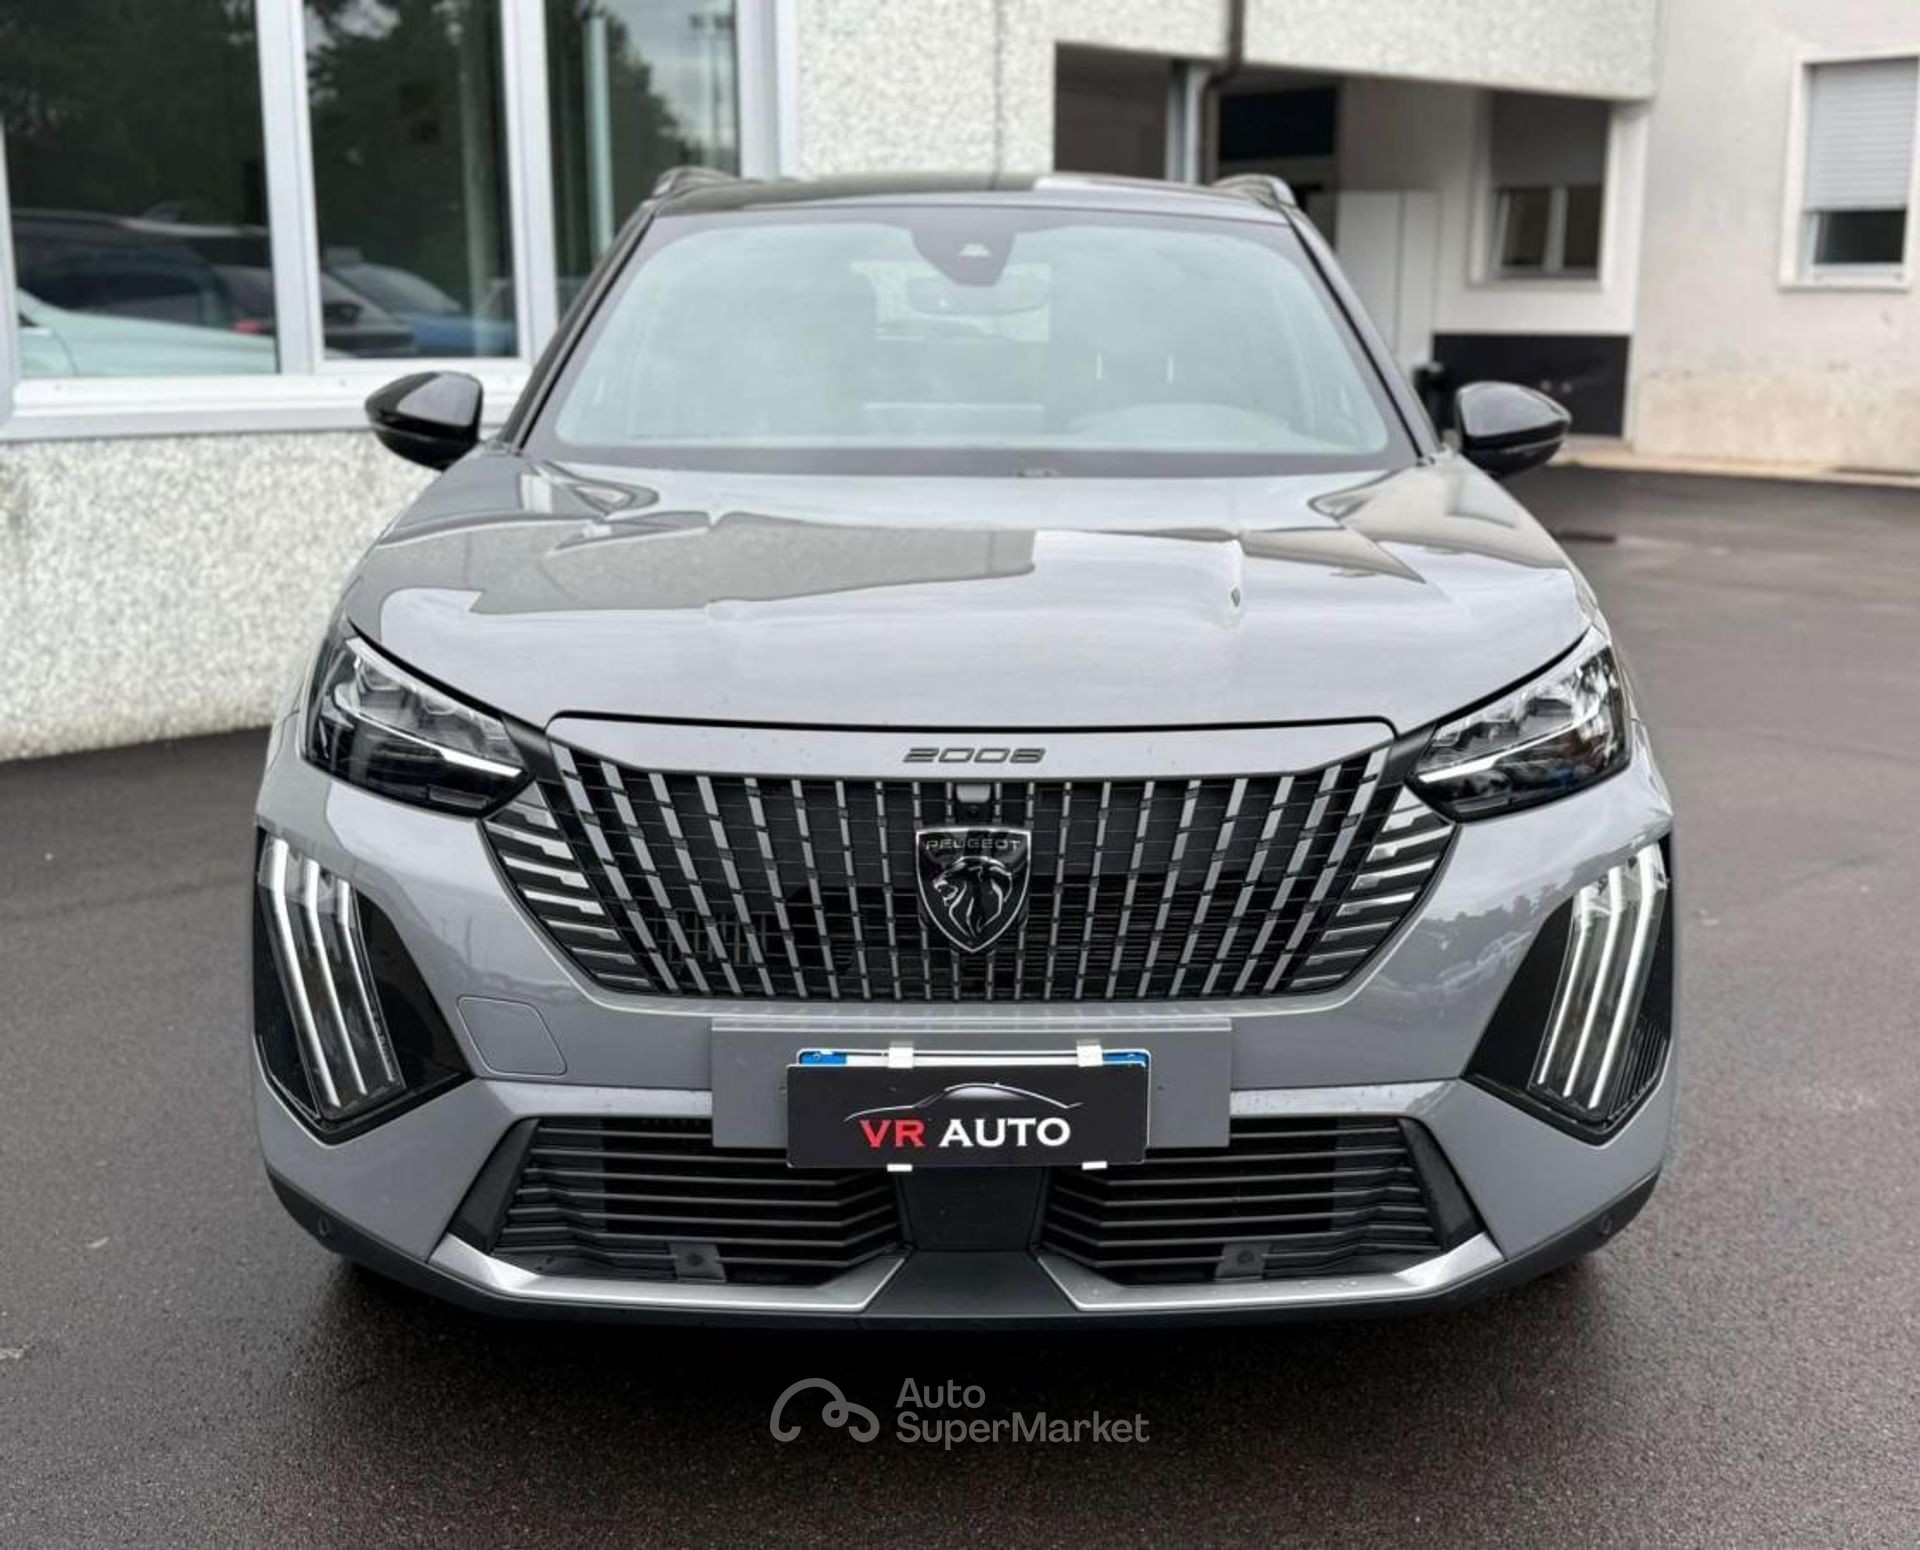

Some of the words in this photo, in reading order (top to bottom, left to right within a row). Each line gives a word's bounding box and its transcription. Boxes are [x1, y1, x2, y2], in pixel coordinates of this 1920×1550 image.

[903, 748, 1046, 763] 2008
[926, 839, 1021, 850] PEUGEOT
[860, 1120, 926, 1147] VR
[939, 1117, 1071, 1147] AUTO
